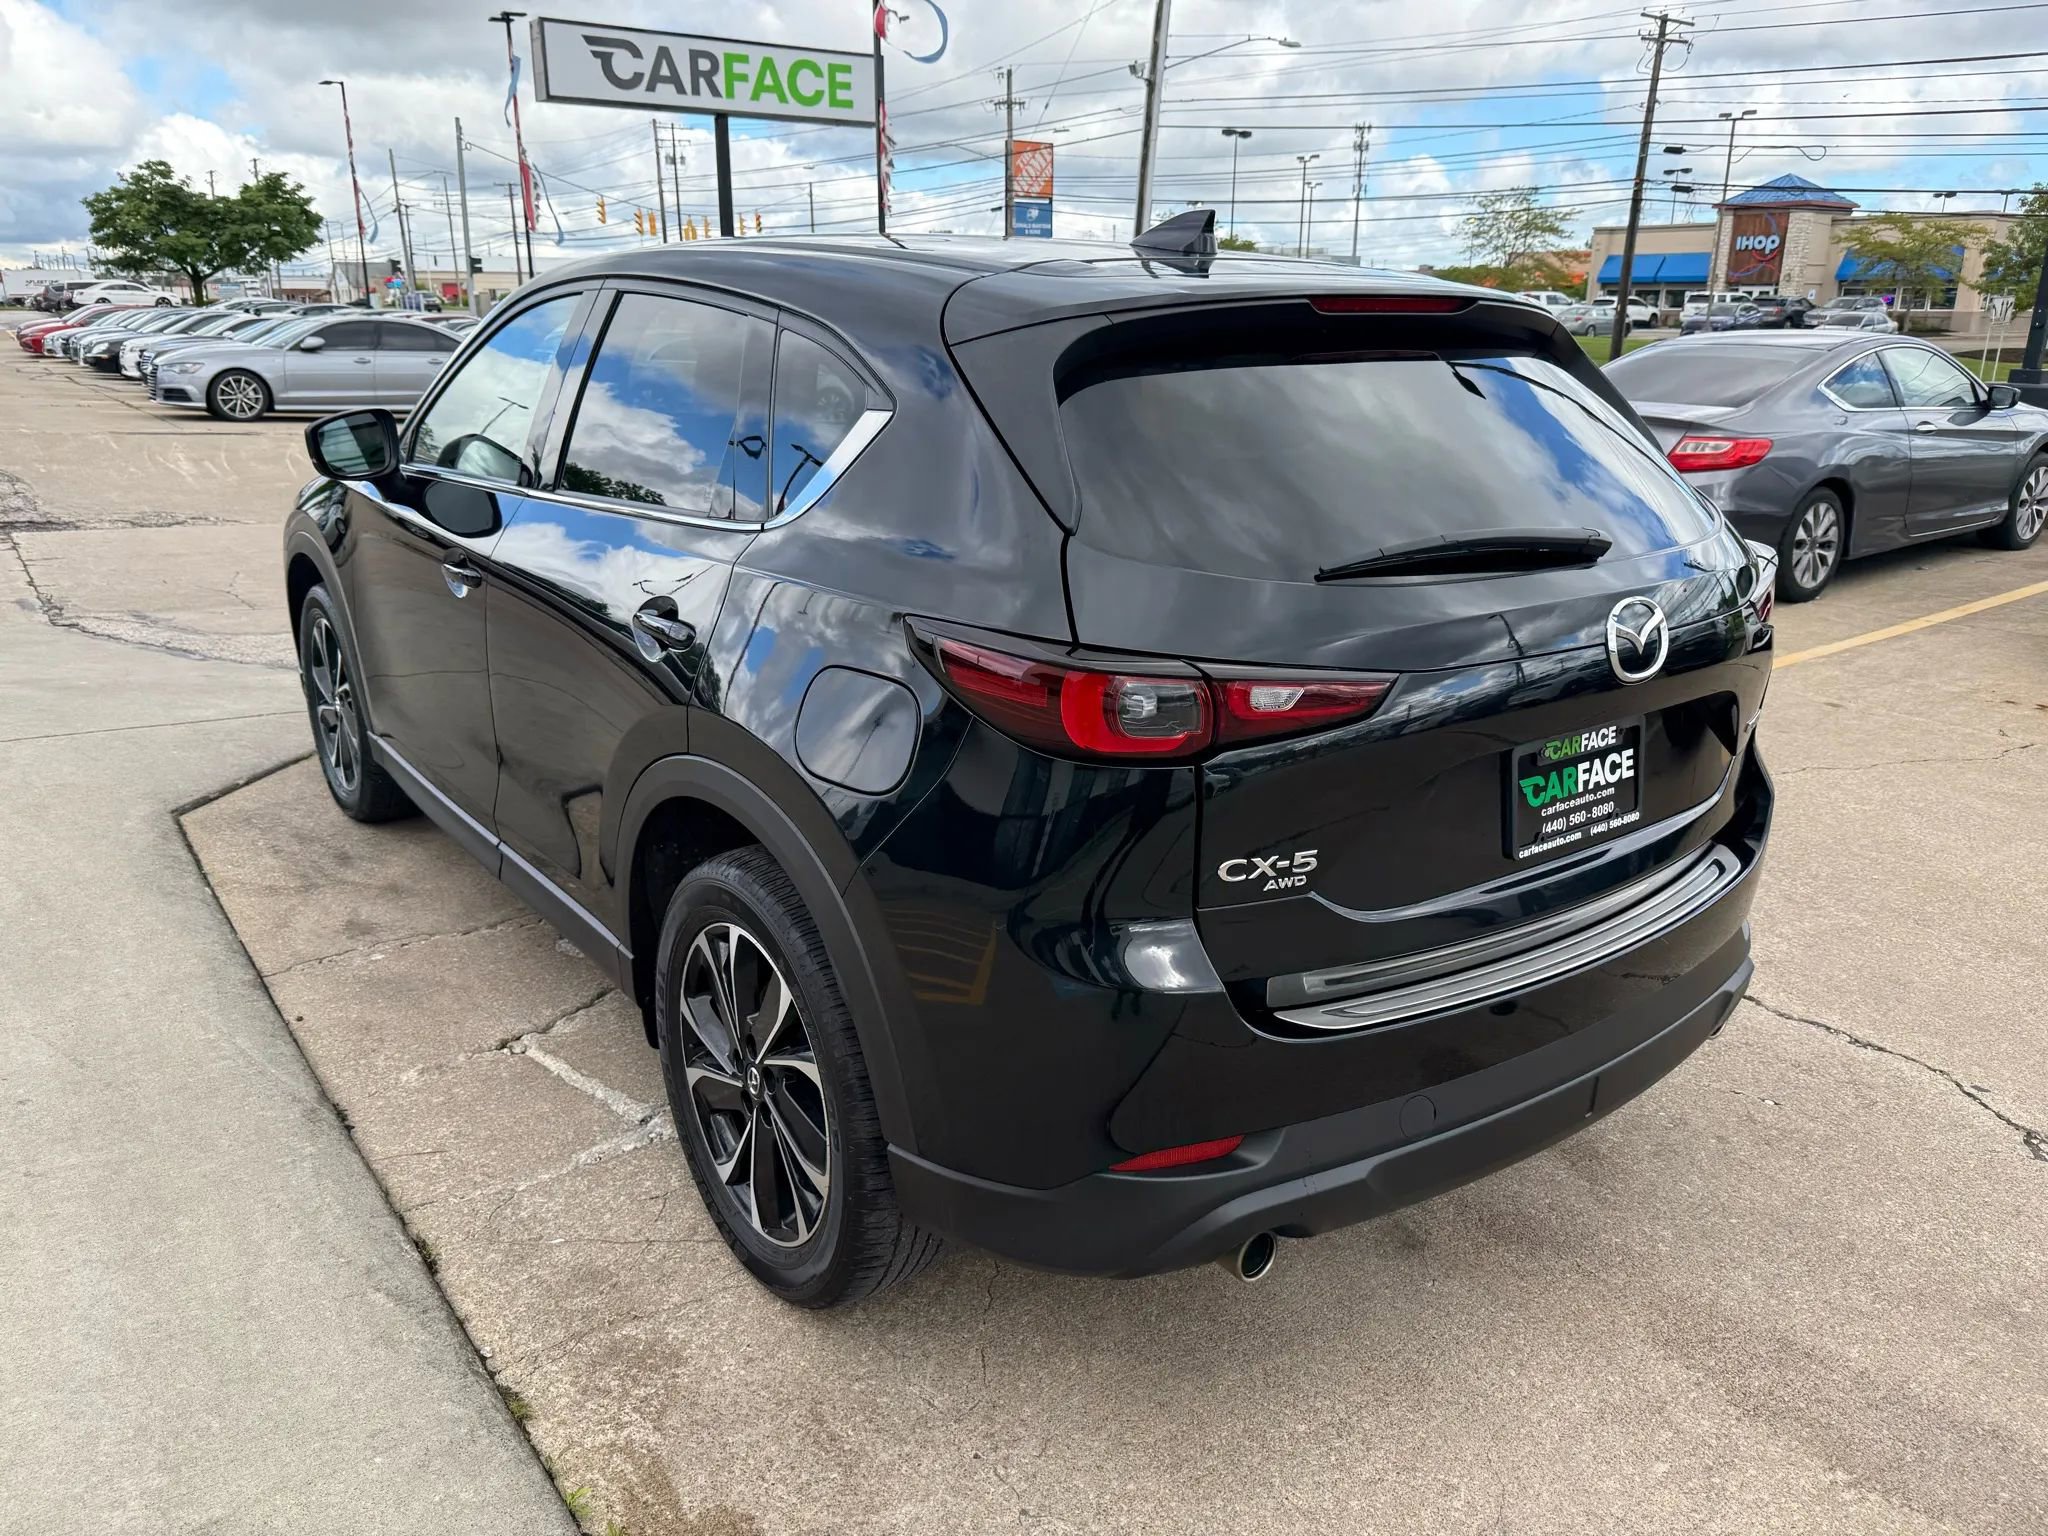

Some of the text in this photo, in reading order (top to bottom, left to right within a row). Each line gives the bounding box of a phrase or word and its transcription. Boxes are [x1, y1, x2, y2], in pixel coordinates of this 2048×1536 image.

[582, 35, 854, 109] CARFACE
[1545, 726, 1617, 760] CARFACE
[1519, 748, 1635, 808] CARFACE
[1541, 787, 1615, 817] carfaceauto.com
[1518, 811, 1640, 859] carfaceauto.com (440) 560-8080
[1542, 816, 1567, 834] (440)
[1217, 849, 1318, 882] CX-5
[1263, 875, 1307, 892] AWD
